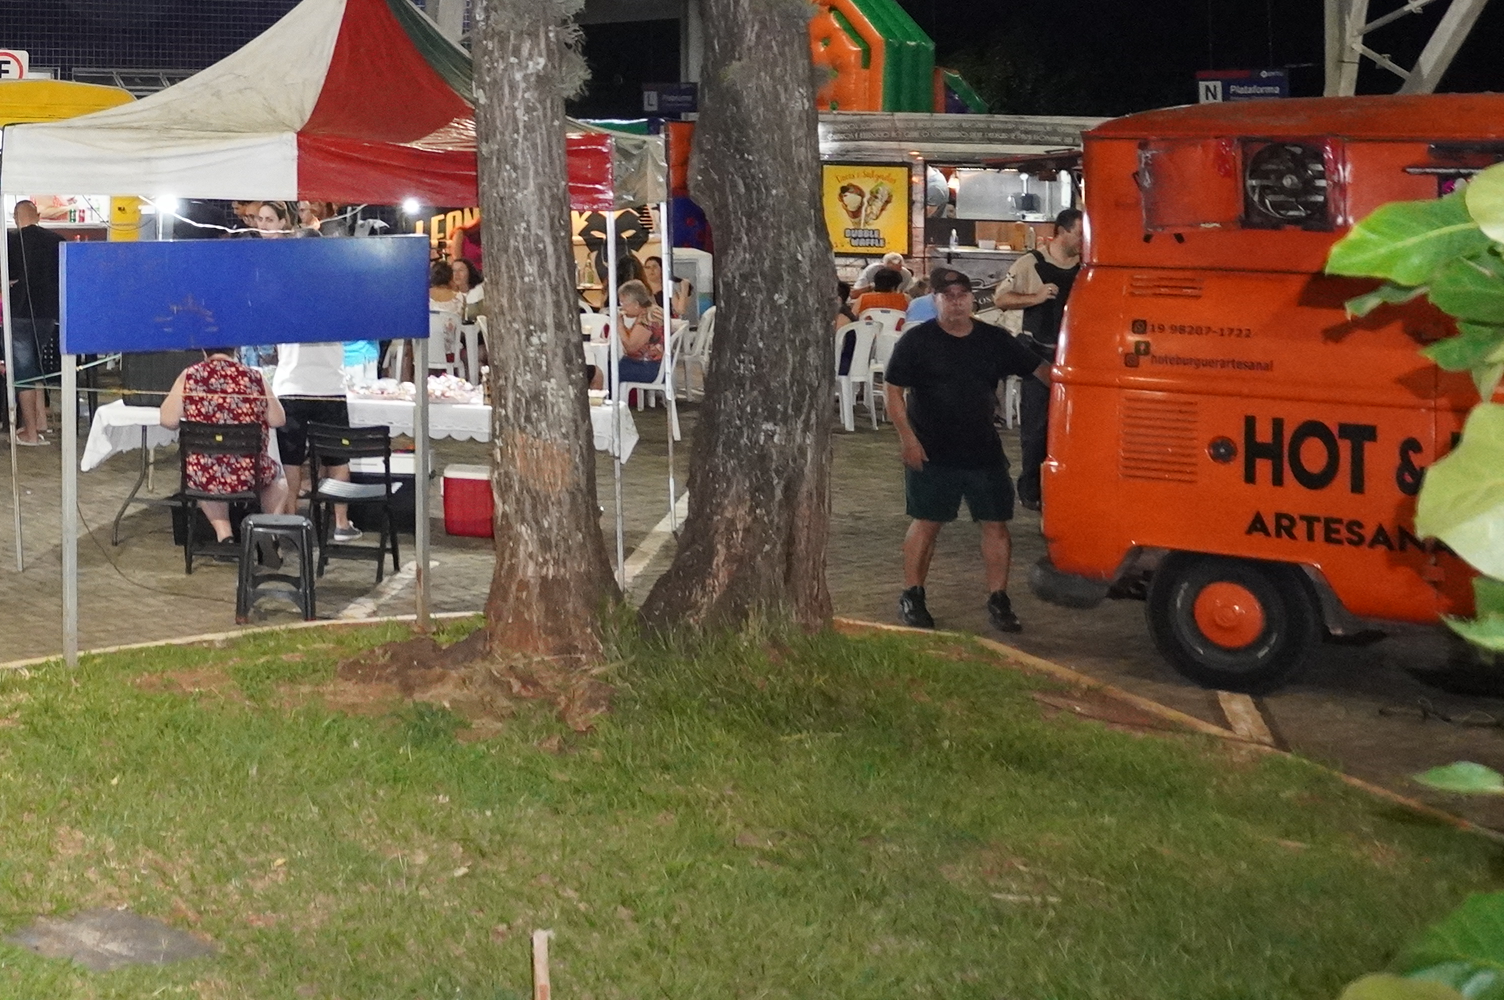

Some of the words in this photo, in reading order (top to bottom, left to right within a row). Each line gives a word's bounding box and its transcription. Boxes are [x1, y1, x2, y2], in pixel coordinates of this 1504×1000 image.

[1205, 84, 1217, 101] N
[1229, 85, 1280, 95] Plataforma
[1150, 323, 1165, 333] 19
[1243, 415, 1378, 495] HOT
[1396, 437, 1428, 496] &
